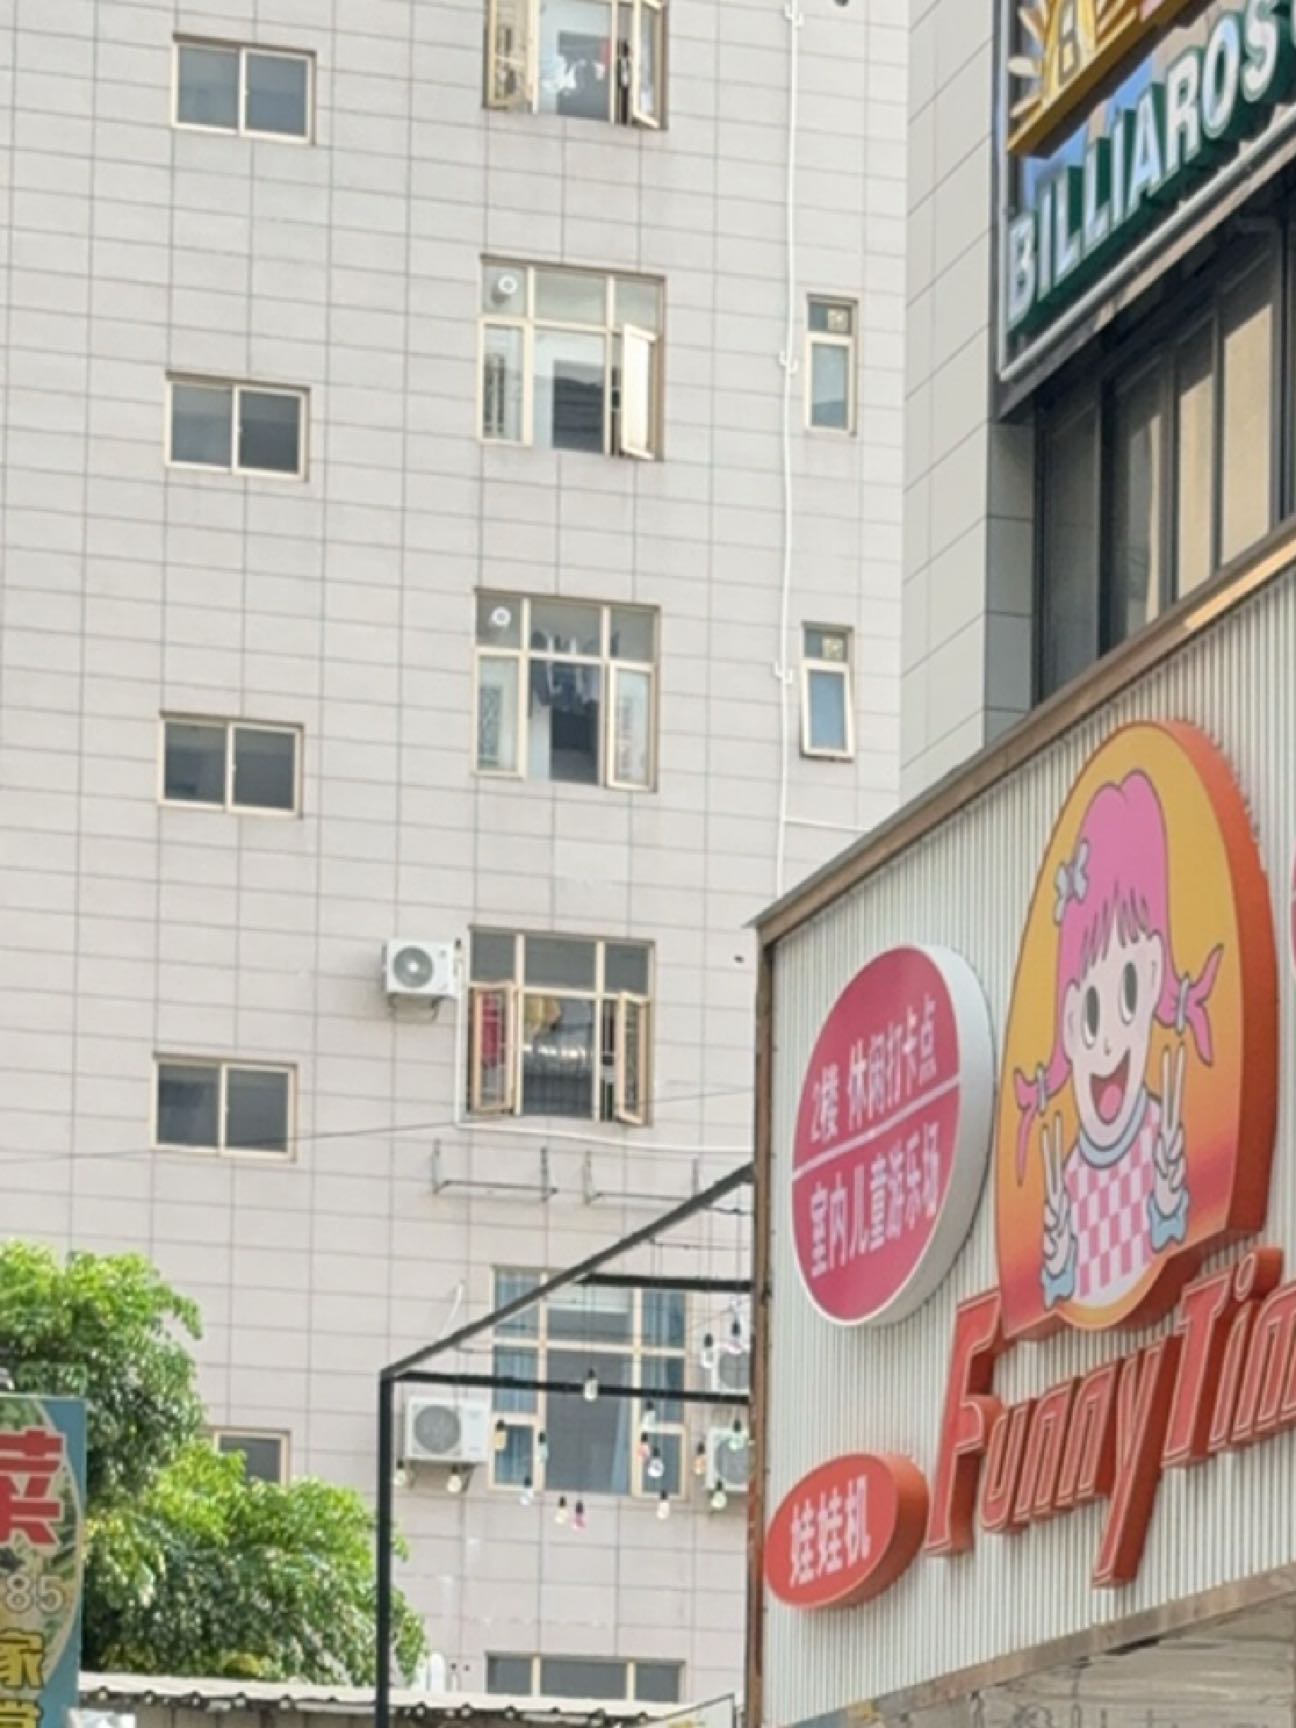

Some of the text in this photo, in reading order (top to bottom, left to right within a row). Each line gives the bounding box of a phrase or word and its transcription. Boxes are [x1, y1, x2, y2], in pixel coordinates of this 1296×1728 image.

[810, 1122, 940, 1279] 室内儿童游乐场
[789, 1474, 873, 1589] 娃娃机
